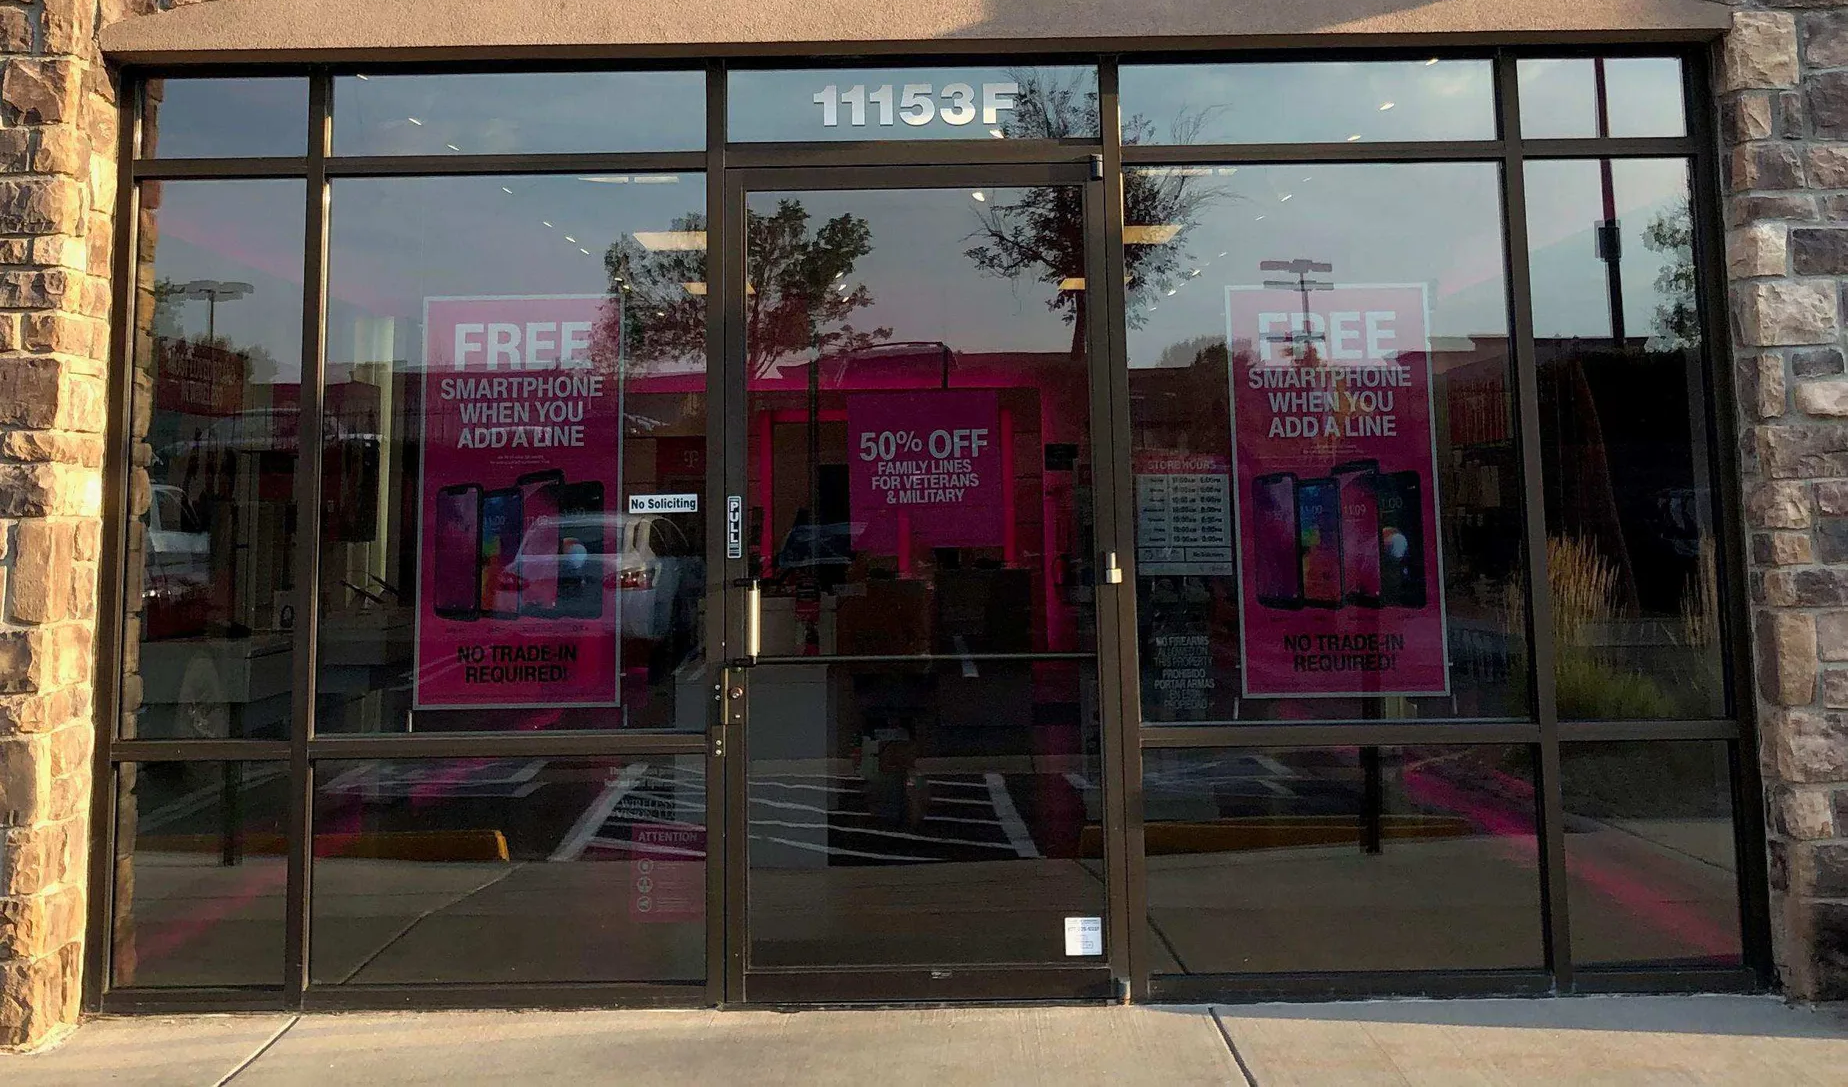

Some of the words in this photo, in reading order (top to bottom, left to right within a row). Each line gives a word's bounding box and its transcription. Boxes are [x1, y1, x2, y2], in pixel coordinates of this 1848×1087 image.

[813, 82, 1020, 127] 11153F
[454, 321, 595, 371] FREE
[1258, 310, 1399, 360] FREE
[440, 376, 604, 400] SMARTPHONE
[1247, 366, 1412, 389] SMARTPHONE
[459, 402, 530, 424] WHEN
[534, 401, 584, 423] YOU
[1267, 391, 1340, 414] WHEN
[1343, 390, 1395, 413] YOU
[457, 427, 508, 449] ADD
[511, 427, 529, 448] A
[533, 426, 585, 448] LINE
[1268, 416, 1319, 439] ADD
[1323, 416, 1341, 438] A
[1344, 415, 1398, 437] LINE
[859, 430, 923, 462] 50%
[928, 428, 988, 459] OFF
[878, 460, 929, 475] FAMILY
[931, 459, 972, 473] LINES
[871, 476, 901, 490] FOR
[904, 473, 980, 489] VETERANS
[631, 499, 645, 510] No
[648, 497, 696, 510] Soliciting
[886, 491, 897, 504] &
[899, 489, 966, 504] MILITARY
[729, 501, 739, 543] PULL
[457, 645, 485, 663] NO
[490, 644, 578, 662] TRADE-IN
[1283, 633, 1311, 652] NO
[1315, 633, 1405, 651] TRADE-IN
[1293, 653, 1397, 672] REQUIRED!
[465, 665, 569, 684] REQUIRED!
[637, 831, 698, 843] ATTENTION
